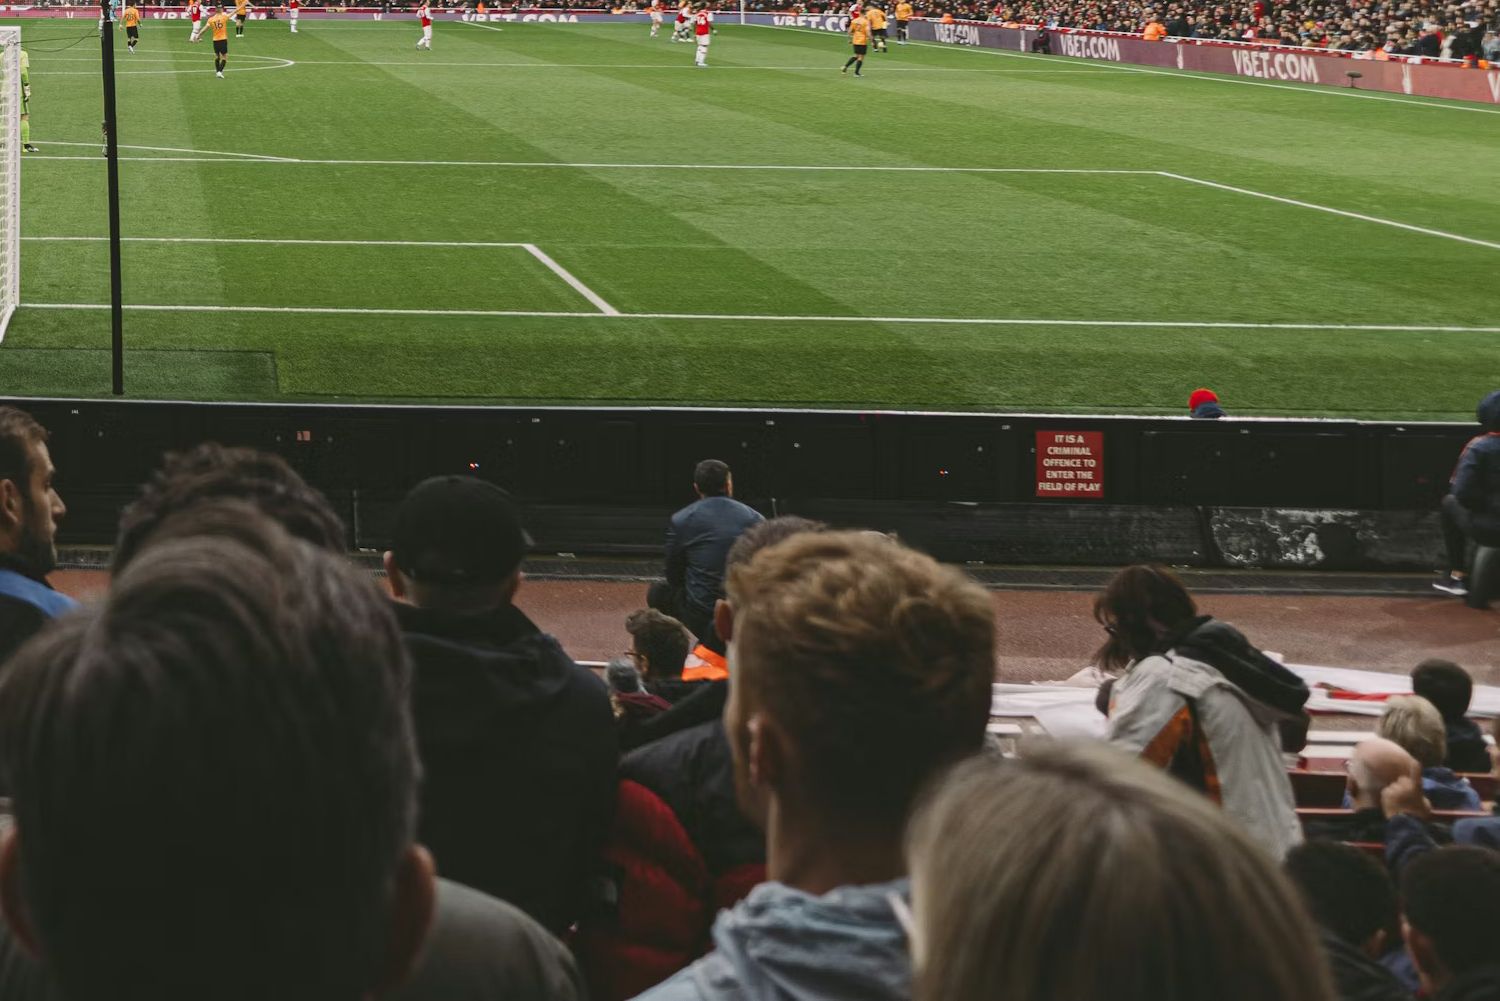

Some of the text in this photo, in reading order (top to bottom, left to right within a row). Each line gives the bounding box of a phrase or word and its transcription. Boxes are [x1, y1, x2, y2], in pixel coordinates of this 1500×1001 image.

[461, 13, 579, 23] VBETCOM
[214, 21, 223, 30] 16
[1060, 34, 1121, 62] VBET.COM
[1231, 49, 1319, 84] VBET.COM
[1054, 434, 1084, 443] IT IS A
[1047, 446, 1092, 455] CRIMINAL
[1043, 458, 1096, 467] OFFENCE TO
[1045, 470, 1093, 479] ENTER THE
[1038, 482, 1102, 491] FIELD OF PLAY
